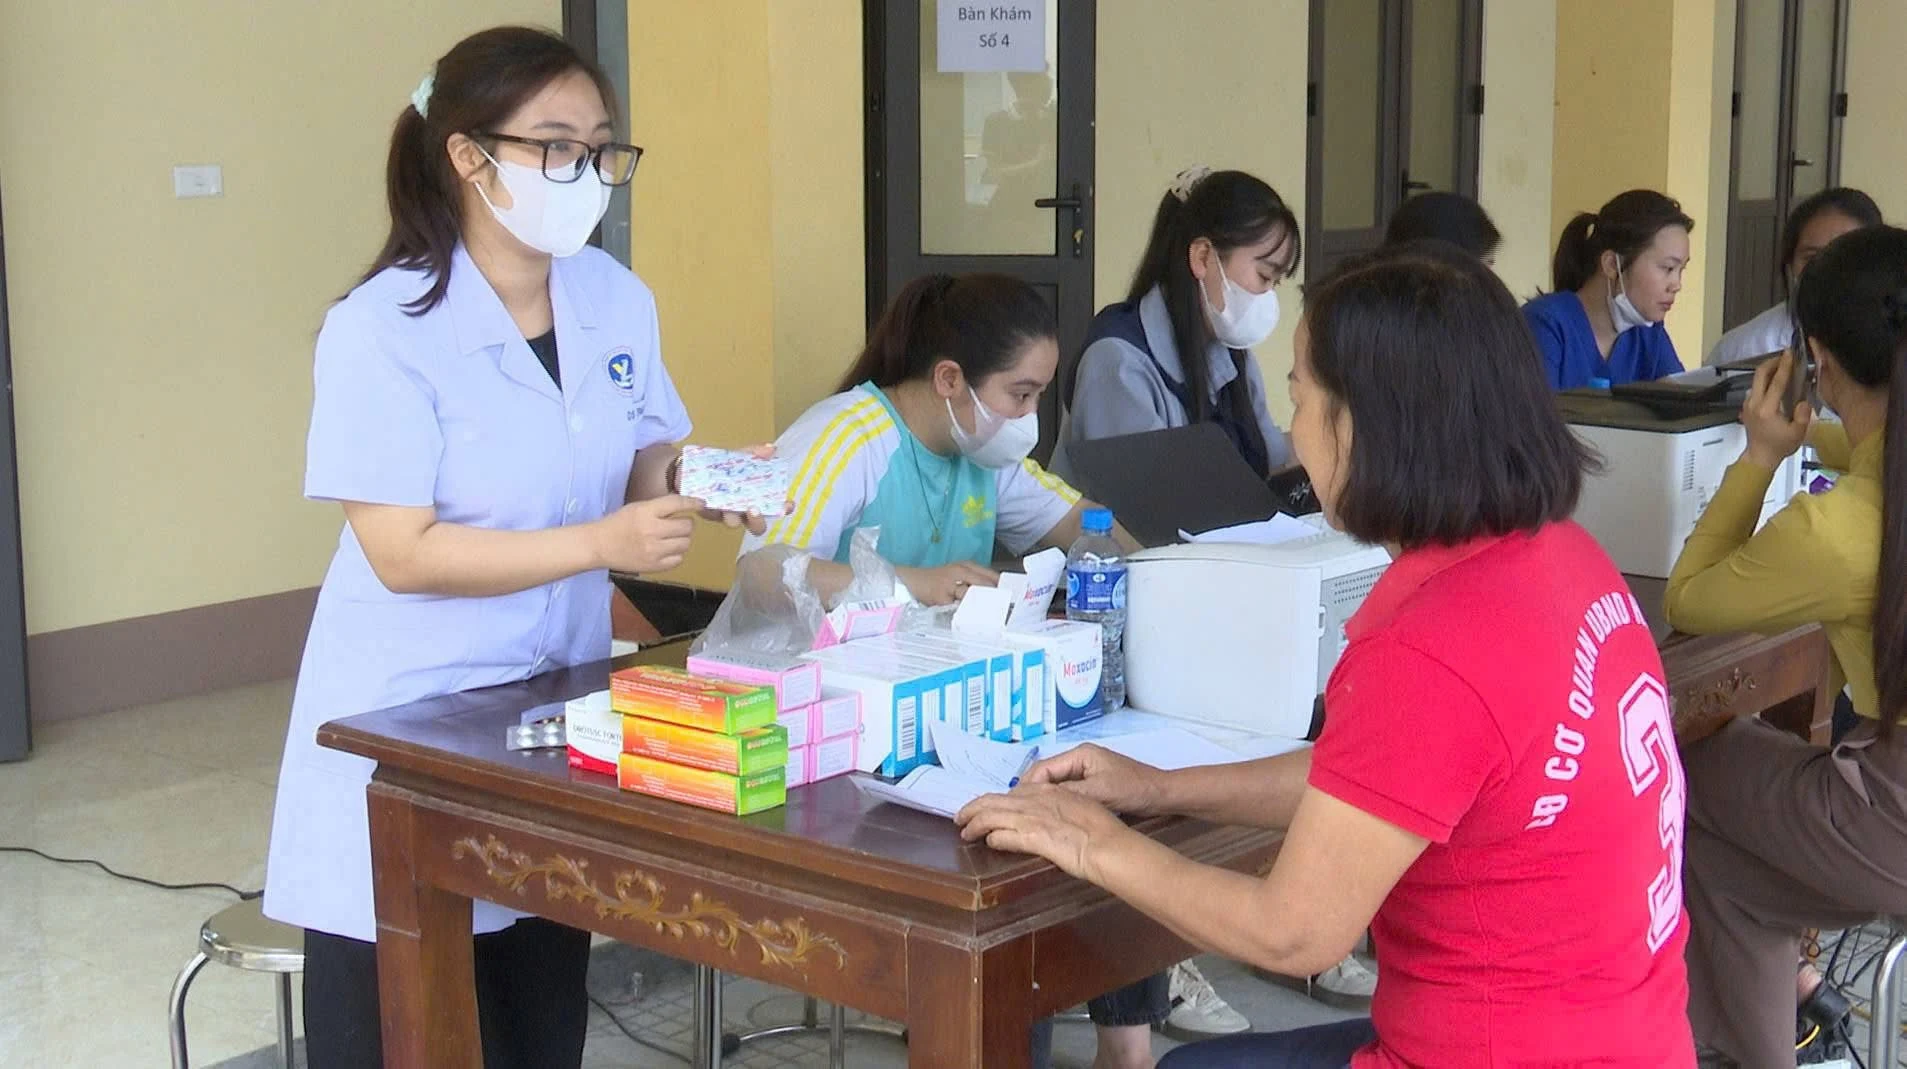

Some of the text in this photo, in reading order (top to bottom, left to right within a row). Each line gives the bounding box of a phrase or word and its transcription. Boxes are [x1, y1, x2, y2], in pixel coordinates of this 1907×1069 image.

[958, 5, 1032, 21] Bàn Khám
[979, 31, 1010, 48] Số 4
[1544, 722, 1586, 782] CƠ
[1568, 626, 1600, 721] QUAN
[1584, 591, 1631, 645] UBND
